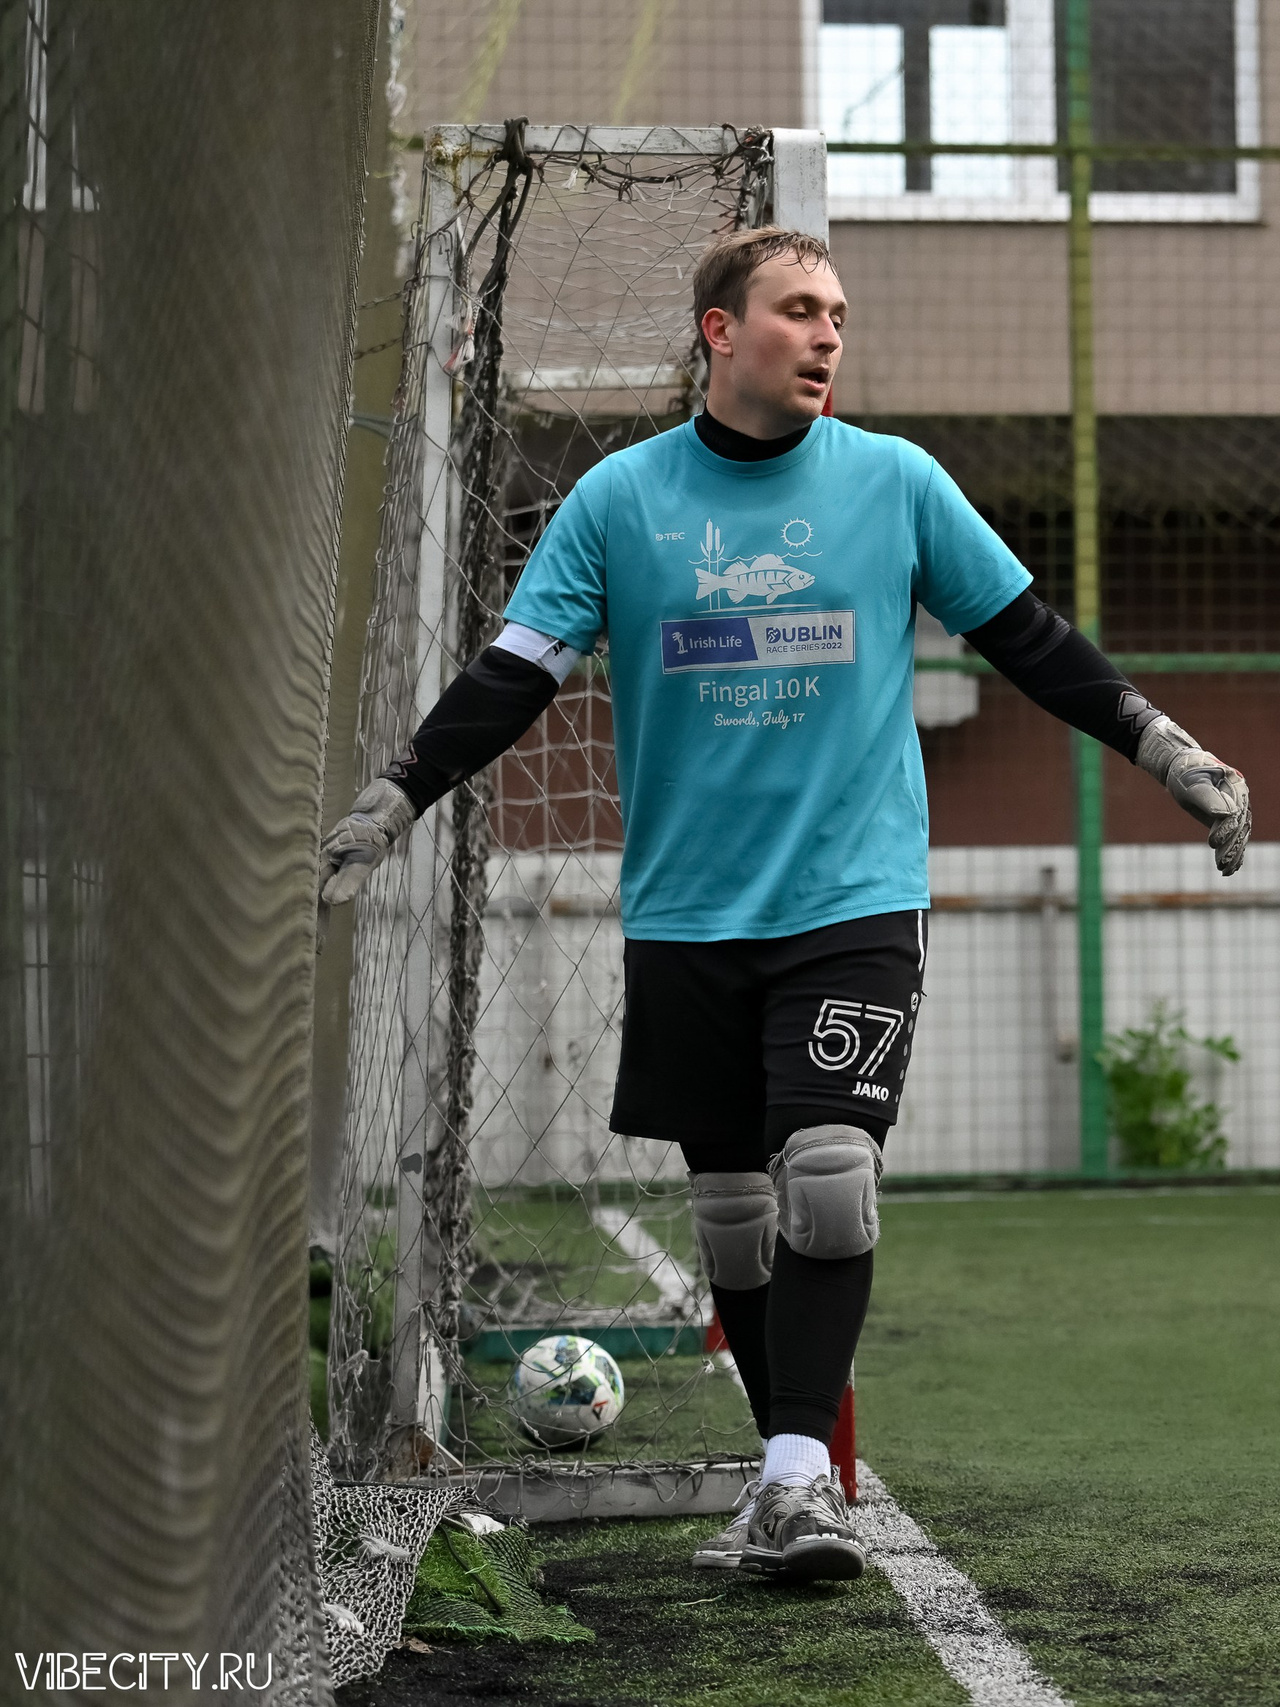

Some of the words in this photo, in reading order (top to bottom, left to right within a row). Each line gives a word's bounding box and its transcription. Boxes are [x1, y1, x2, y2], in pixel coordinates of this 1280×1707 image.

[689, 636, 717, 649] Irish
[719, 635, 743, 649] Life
[766, 624, 843, 644] DUBLIN
[766, 645, 788, 654] RACE
[790, 643, 820, 653] SERIES
[821, 641, 843, 650] 2022
[699, 678, 768, 708] Fingal
[713, 710, 760, 728] Swords,
[761, 708, 791, 730] July
[792, 712, 806, 723] 17
[808, 998, 904, 1077] 57
[852, 1081, 889, 1102] JAKO
